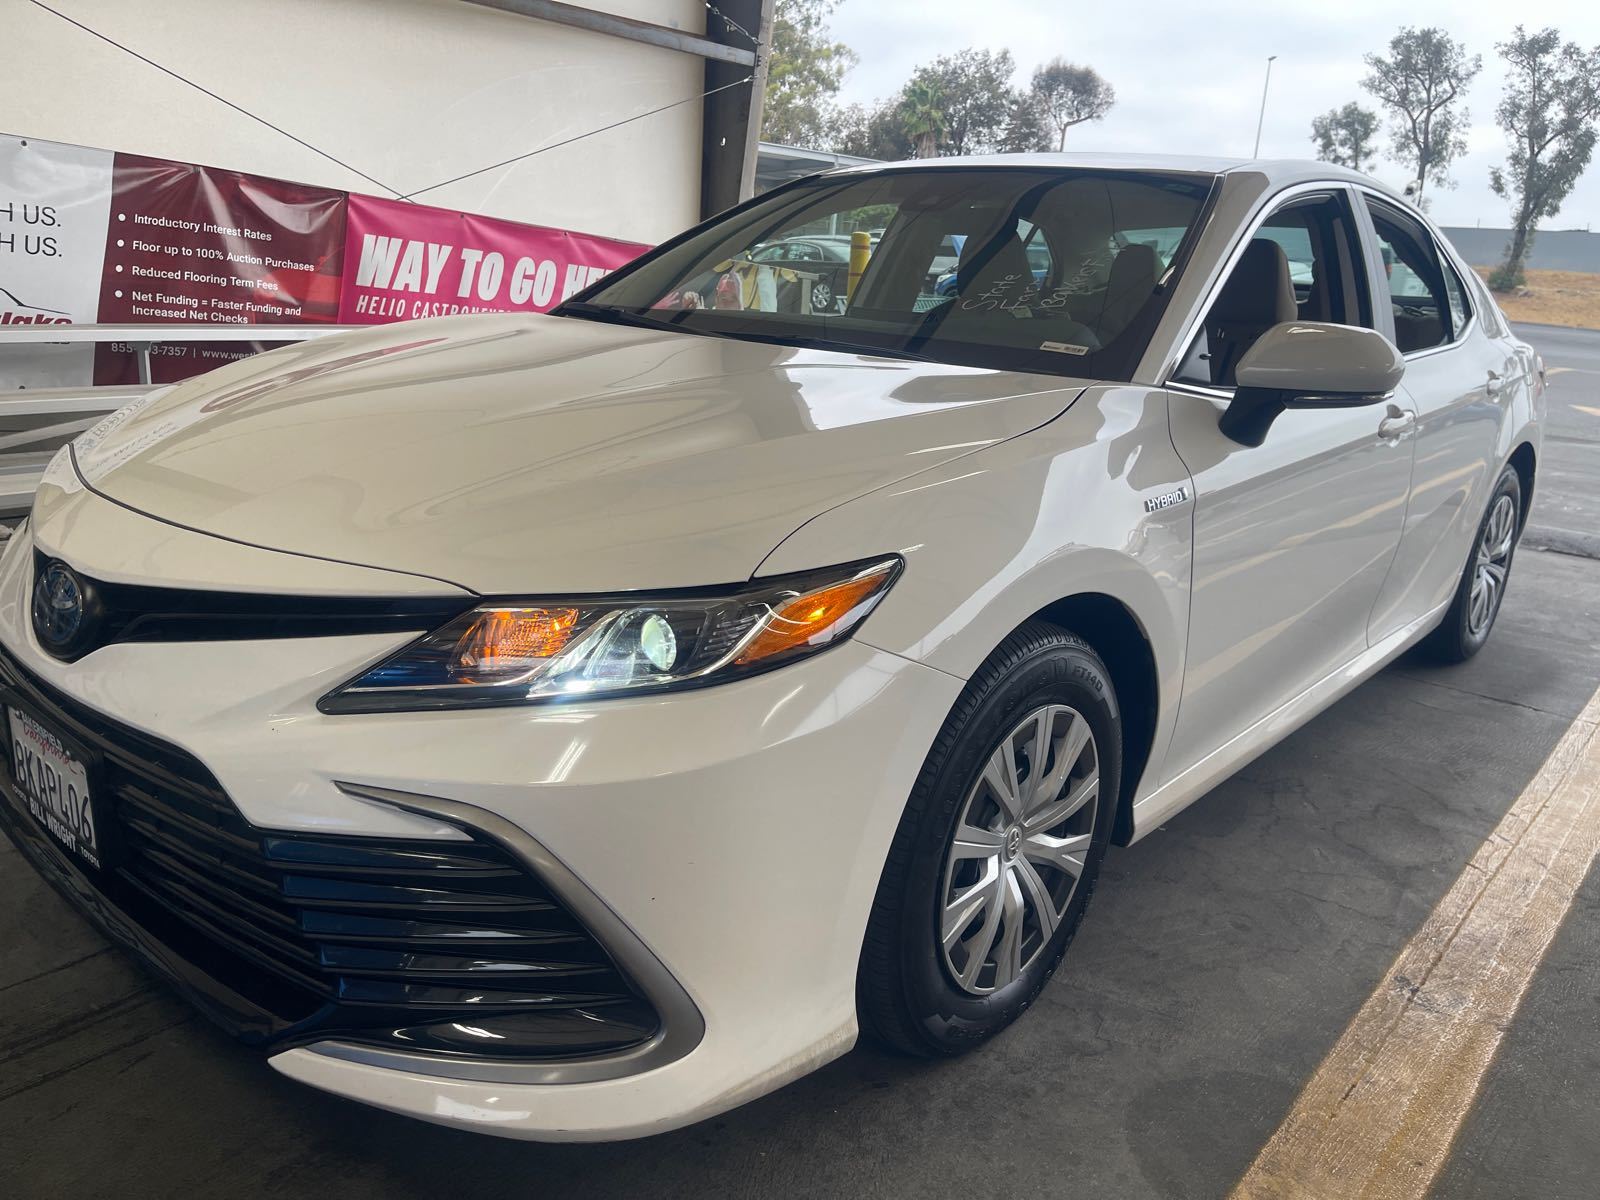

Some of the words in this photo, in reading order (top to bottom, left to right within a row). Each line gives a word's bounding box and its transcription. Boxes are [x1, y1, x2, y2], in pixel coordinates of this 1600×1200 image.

[23, 204, 61, 228] US.
[134, 213, 200, 232] Introductory
[203, 222, 242, 237] Interest
[244, 228, 272, 242] Rates
[25, 234, 62, 258] US.
[132, 240, 161, 253] Floor
[164, 245, 178, 257] up
[181, 246, 193, 256] to
[196, 248, 224, 261] 100%
[227, 252, 263, 266] Auction
[265, 257, 315, 272] Purchases
[132, 265, 181, 280] Reduced
[184, 271, 227, 287] Flooring
[230, 276, 254, 288] Term
[256, 280, 279, 291] Fees
[355, 233, 453, 295] WAY
[457, 248, 505, 302] TO
[509, 256, 557, 307] GO
[132, 291, 153, 302] Net
[156, 293, 199, 307] Funding
[211, 298, 244, 311] Faster
[246, 302, 283, 316] Funding
[284, 306, 302, 316] and
[132, 305, 187, 319] Increased
[189, 309, 208, 321] Net
[210, 312, 249, 325] Checks
[355, 294, 406, 317] HELIO
[1147, 490, 1184, 512] HYBRID
[29, 796, 46, 826] BILL
[46, 813, 77, 852] WRIGHT
[80, 846, 101, 870] TOYOTA
